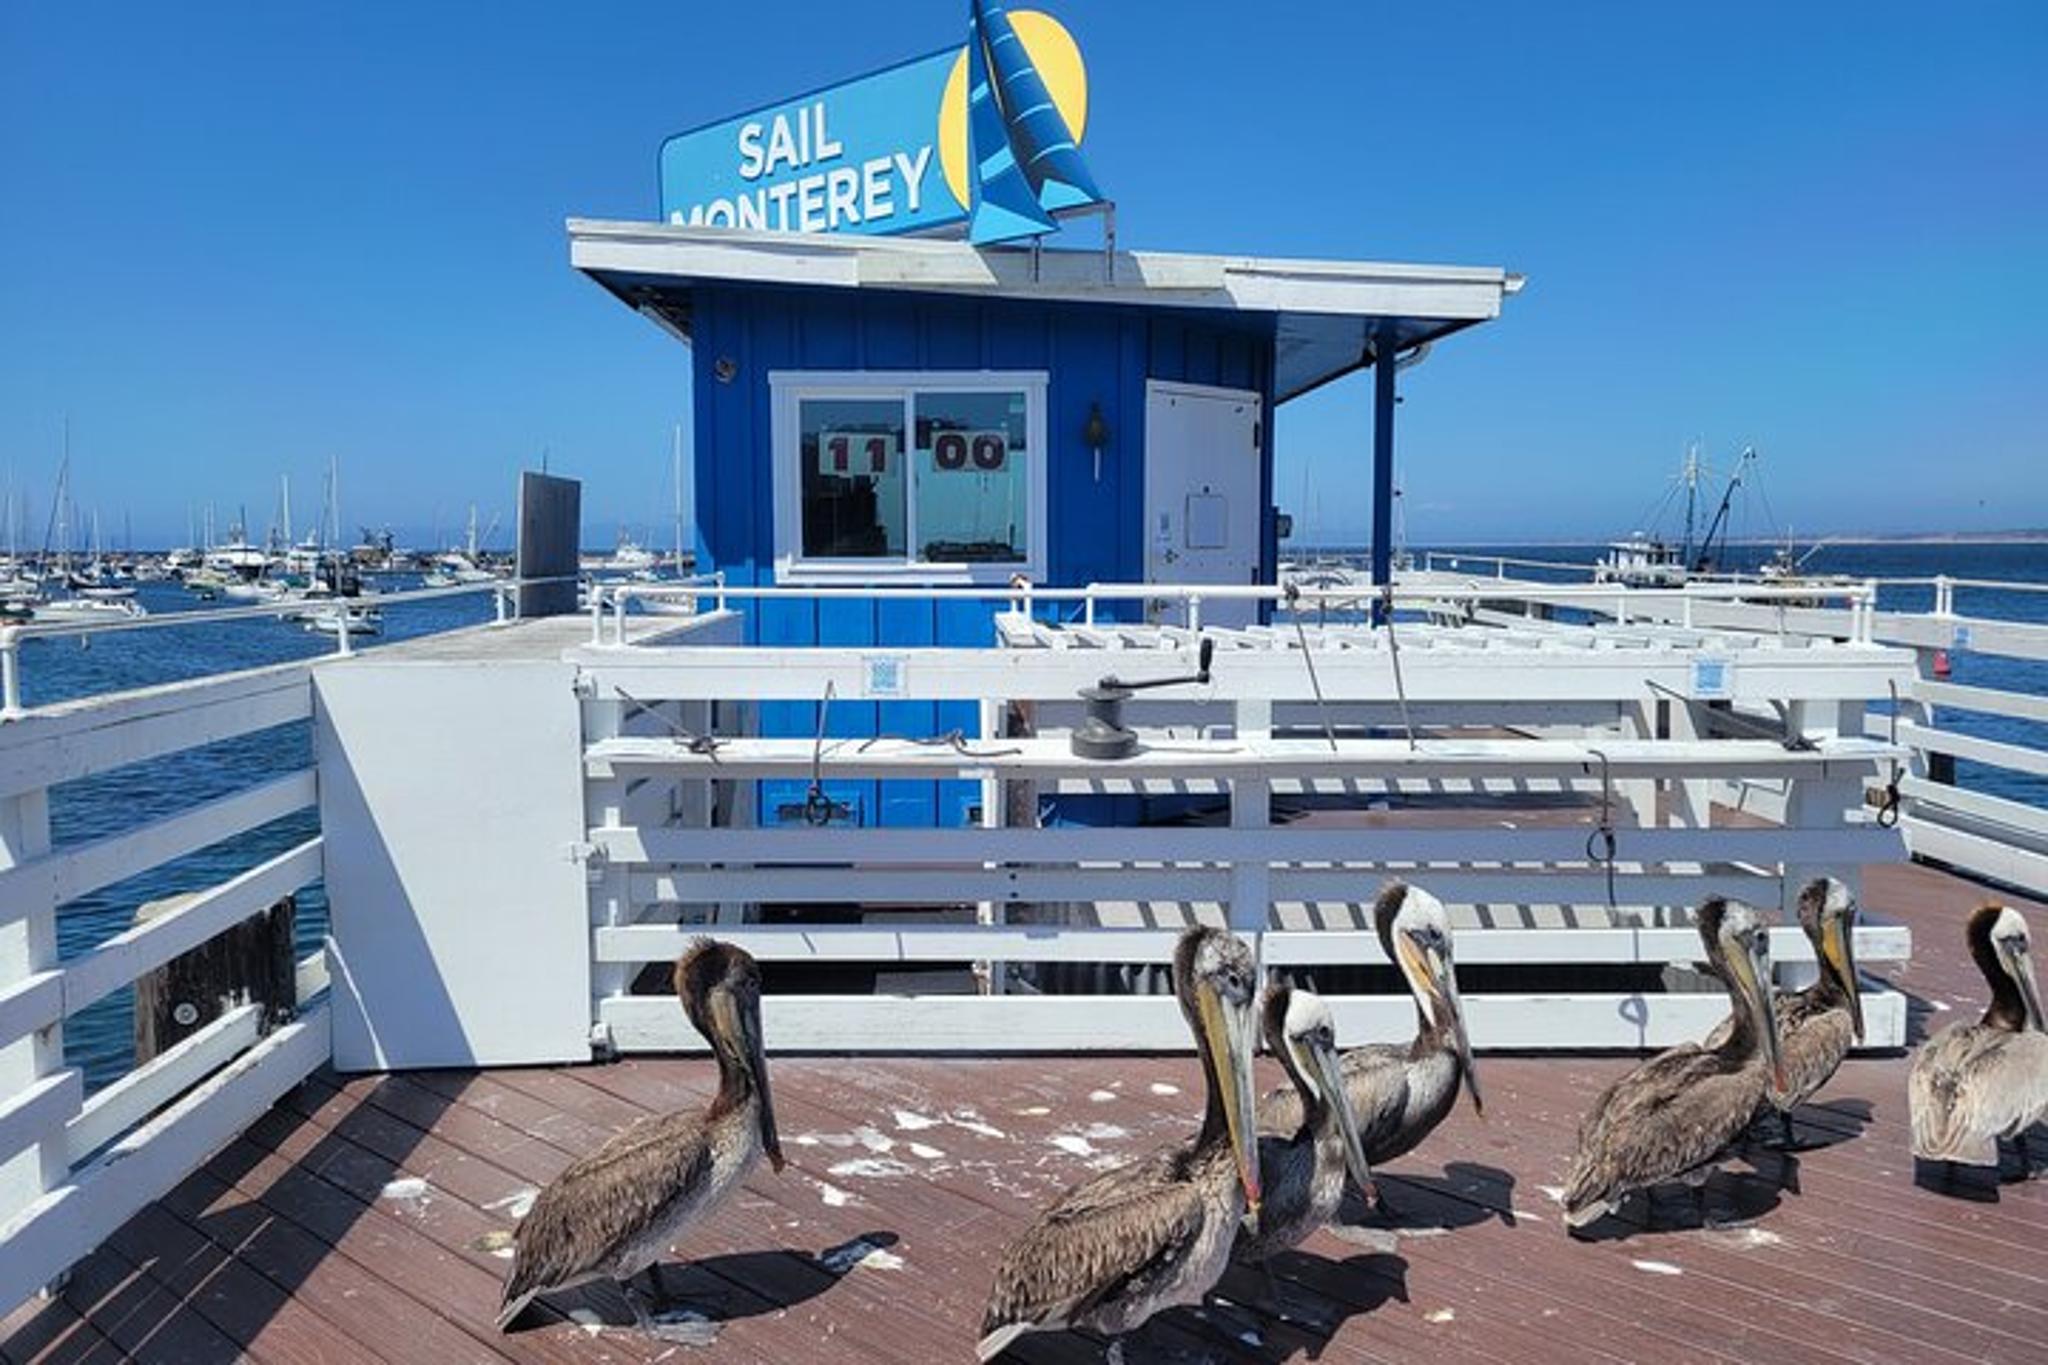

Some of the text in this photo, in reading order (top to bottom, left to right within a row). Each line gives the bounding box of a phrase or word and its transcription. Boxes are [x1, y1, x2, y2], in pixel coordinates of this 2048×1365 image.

[739, 102, 843, 180] SAIL
[828, 434, 1005, 472] 11 00
